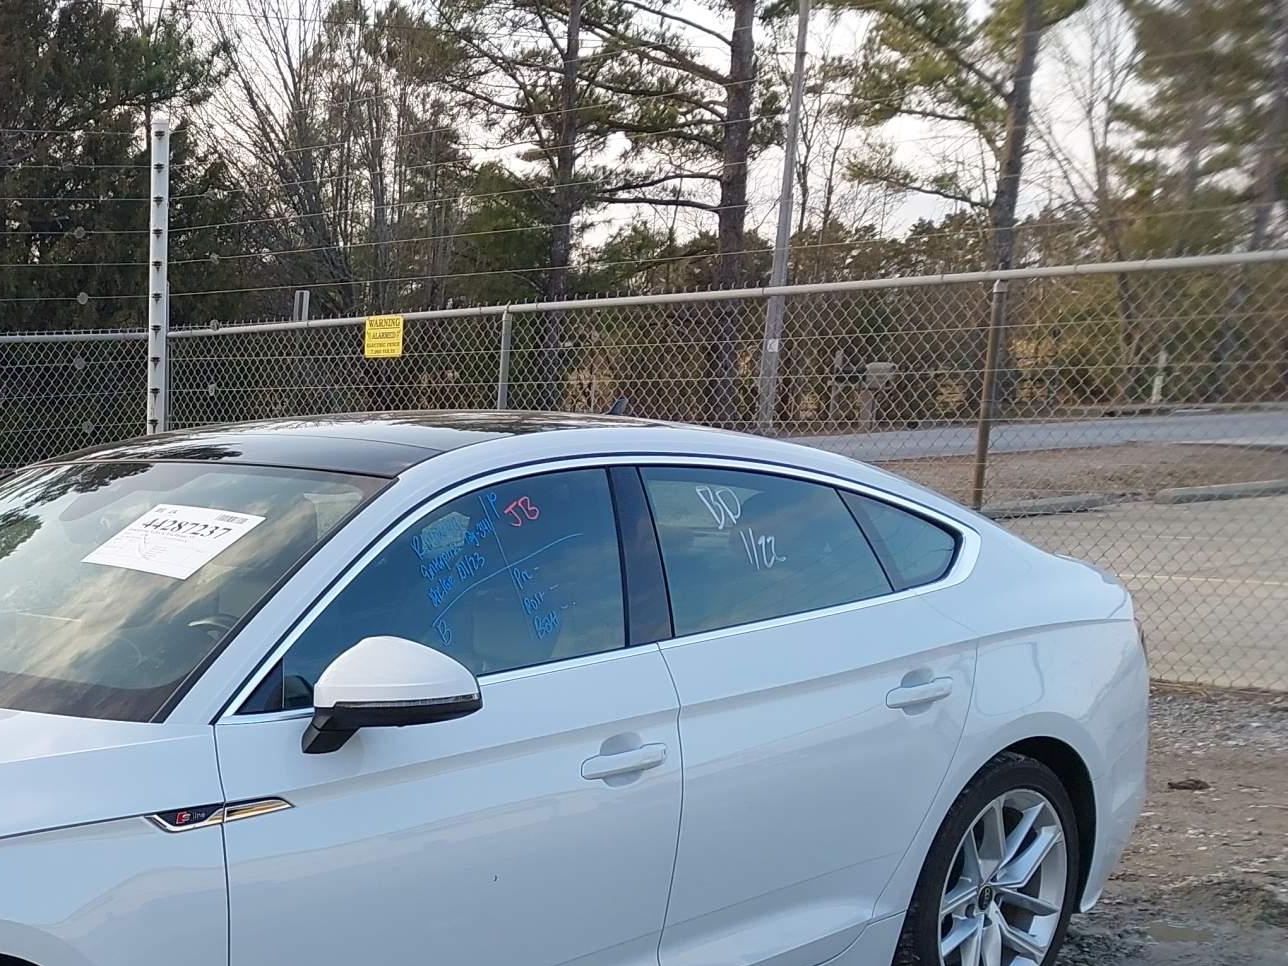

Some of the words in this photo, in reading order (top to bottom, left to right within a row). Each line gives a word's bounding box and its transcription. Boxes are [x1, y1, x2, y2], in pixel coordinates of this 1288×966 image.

[368, 318, 400, 327] WARNING
[503, 496, 540, 527] JB
[142, 518, 232, 539] 44287237
